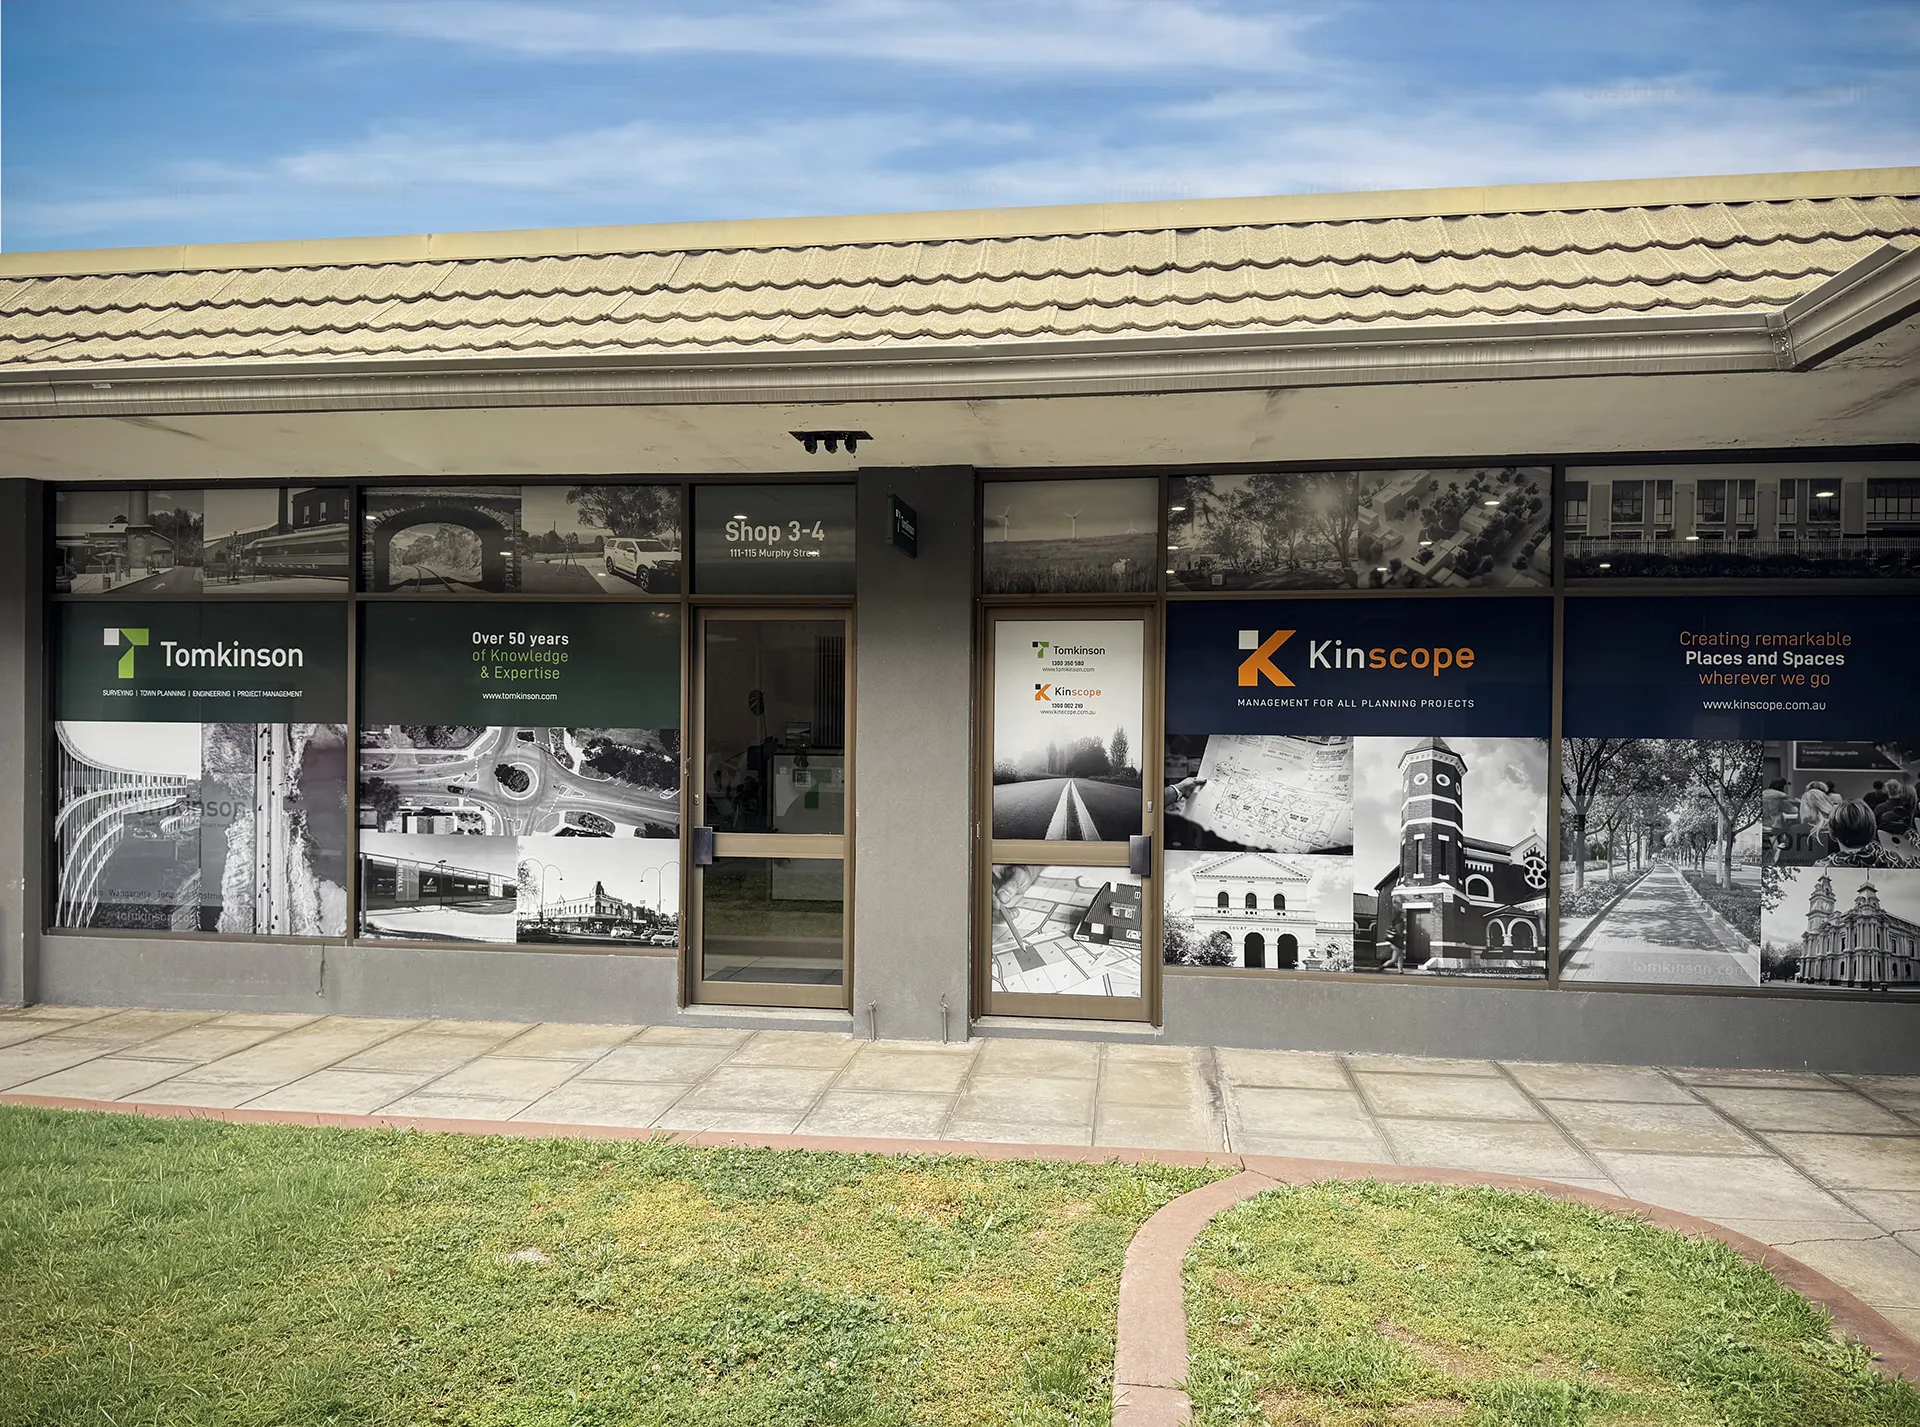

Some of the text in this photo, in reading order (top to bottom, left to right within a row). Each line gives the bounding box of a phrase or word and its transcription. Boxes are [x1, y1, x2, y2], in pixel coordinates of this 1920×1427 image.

[725, 520, 825, 545] Shop 3-4
[730, 549, 757, 558] 111-115
[759, 549, 791, 559] Murphy
[472, 632, 570, 647] Over 50 years
[1679, 631, 1852, 649] Creating remarkable
[160, 641, 303, 667] Tomkinson
[472, 649, 569, 664] of Knowledge
[1053, 646, 1106, 655] Tomkinson
[1310, 639, 1475, 676] Kinscope
[1686, 651, 1845, 668] Places and Spaces
[480, 665, 560, 681] & Expertise
[1699, 671, 1830, 688] wherever we go
[157, 690, 186, 698] PLANNING
[192, 690, 231, 698] ENGINEERING
[237, 690, 262, 698] PROJECT
[482, 692, 558, 700] www.tomkinson.com
[1055, 687, 1101, 698] Kinscope
[1237, 698, 1475, 708] MANAGEMENT FOR ALL PLANNING PROJECTS
[1703, 700, 1826, 711] www.kinscope.com.au
